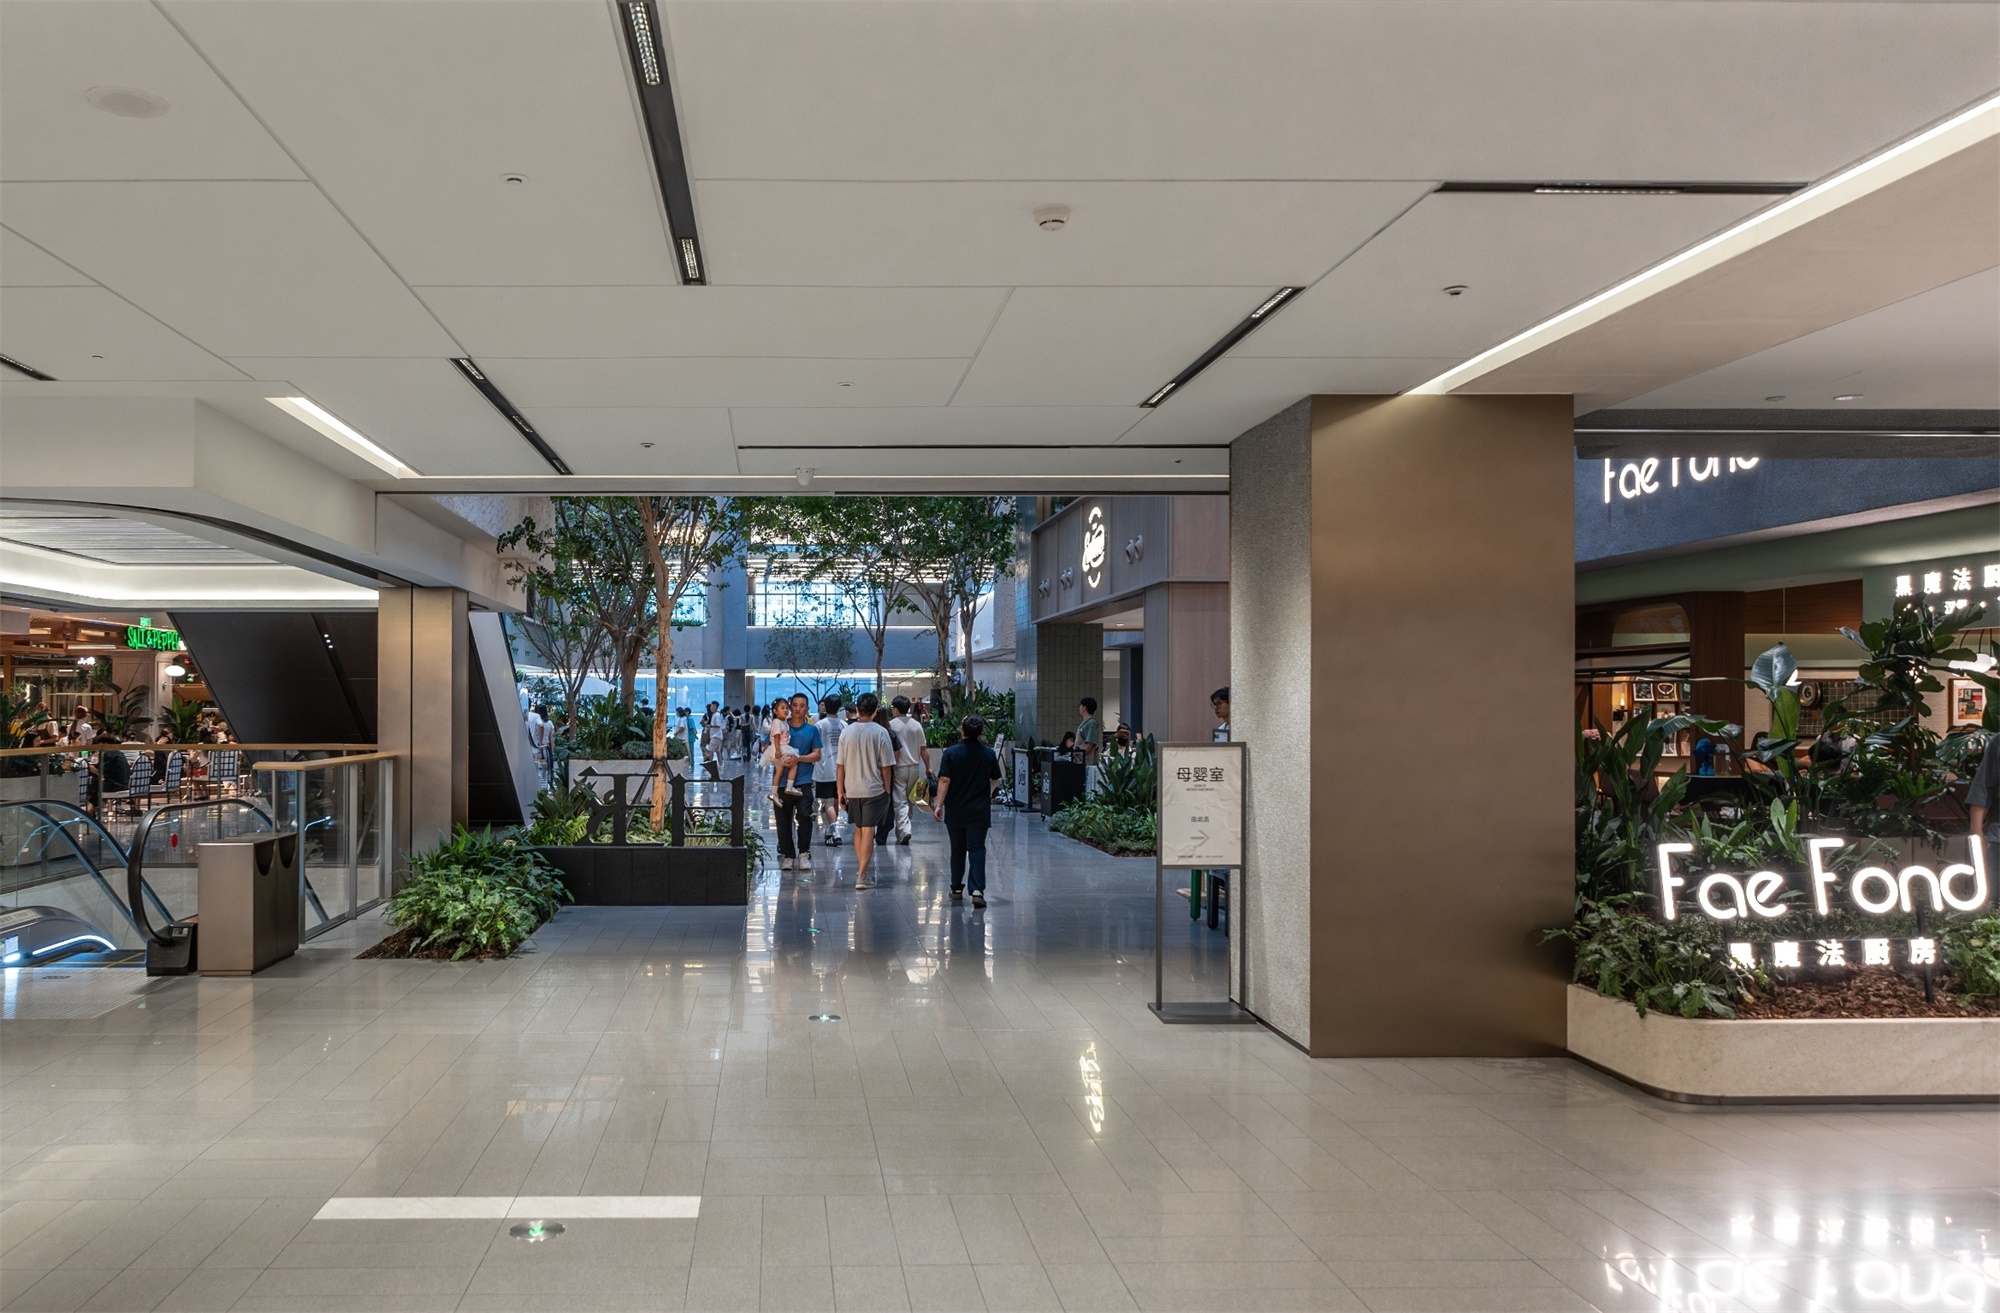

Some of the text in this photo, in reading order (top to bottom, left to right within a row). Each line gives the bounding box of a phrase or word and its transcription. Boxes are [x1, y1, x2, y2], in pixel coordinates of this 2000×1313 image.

[1176, 766, 1224, 782] 母婴室
[1657, 834, 1987, 920] Fae Fond
